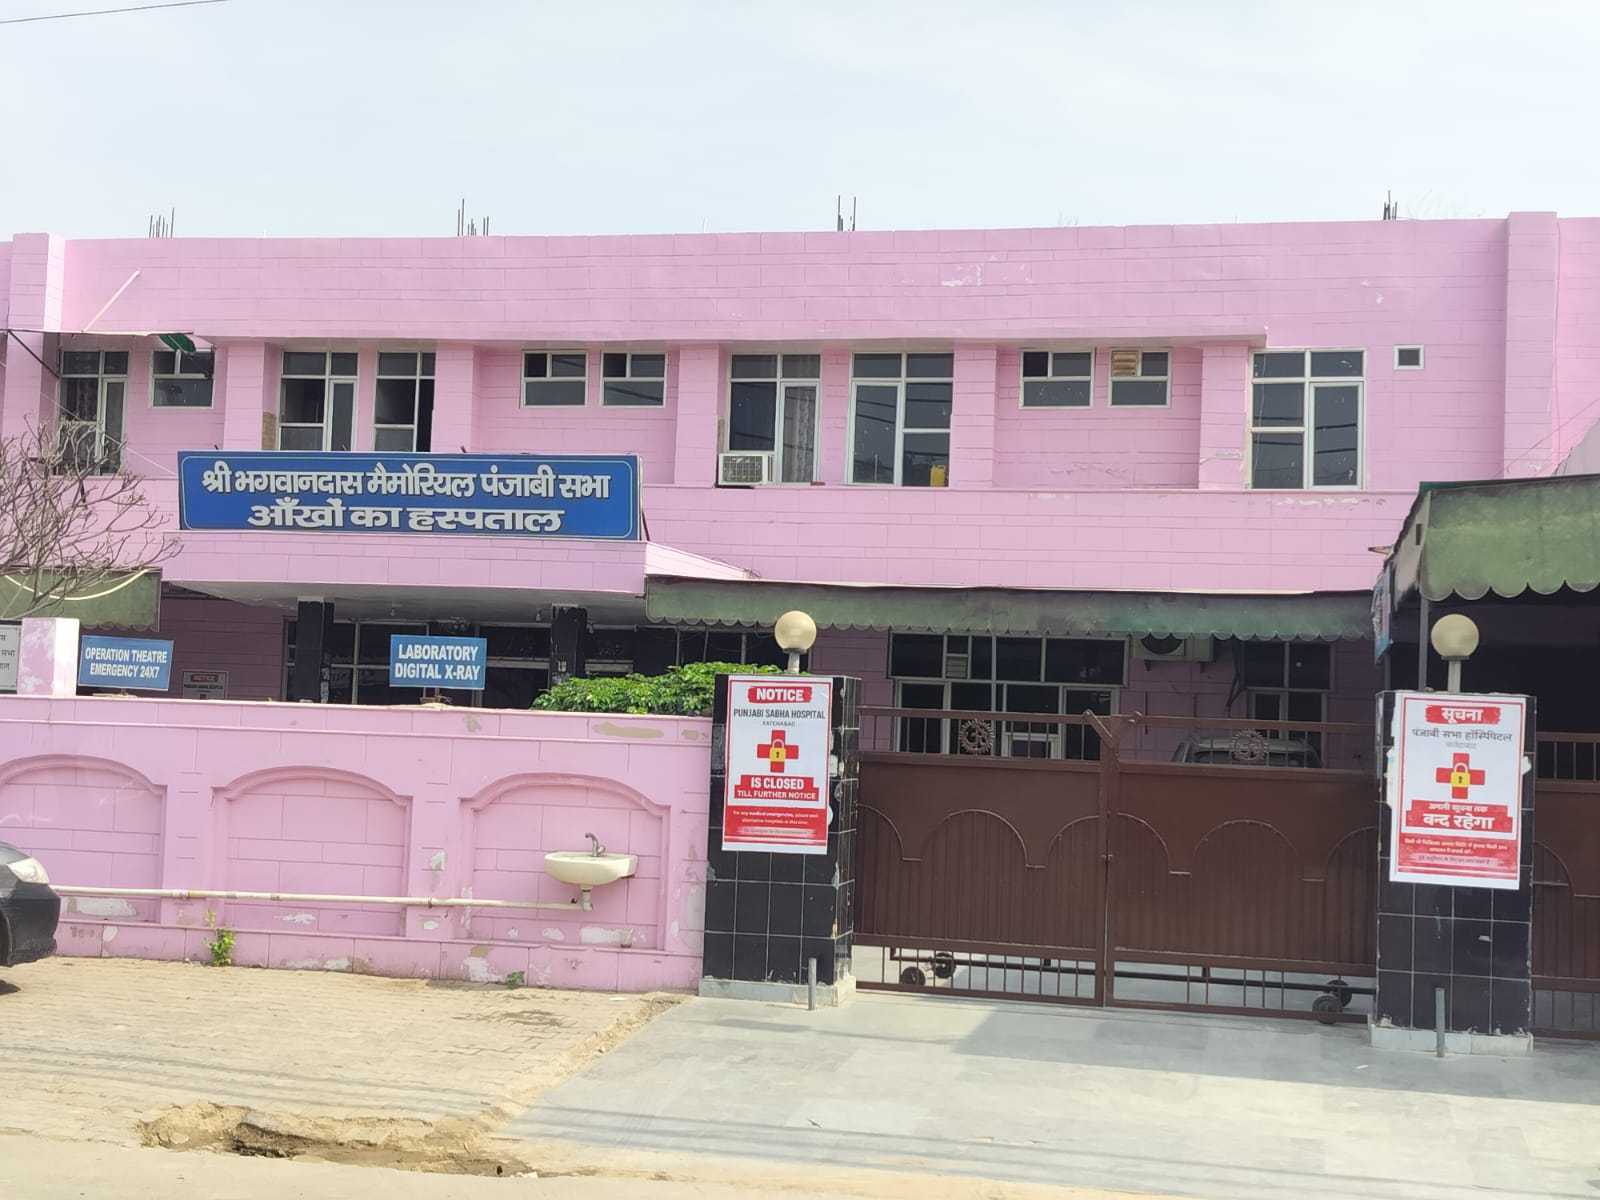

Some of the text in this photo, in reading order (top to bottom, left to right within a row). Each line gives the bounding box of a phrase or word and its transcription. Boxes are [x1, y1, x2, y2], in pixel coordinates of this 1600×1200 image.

[202, 461, 611, 498] श्री भगवानदास मैमोरियल पंजाबी सभा
[350, 506, 402, 528] का
[407, 508, 565, 532] हस्पताल
[86, 647, 168, 663] OPERATION THEATRE
[398, 644, 479, 661] LABORATORY
[90, 662, 160, 678] EMERGENCY 24X7
[395, 662, 480, 680] DIGITAL X-RAY
[756, 688, 804, 702] NOTICE
[734, 708, 826, 719] PUNJABI SABHA HOSPITAL
[1440, 708, 1484, 724] सूचना
[1442, 730, 1462, 739] सभा
[751, 777, 804, 790] IS CLOSED
[788, 792, 816, 800] NOTICE
[1454, 814, 1495, 830] रहेगा
